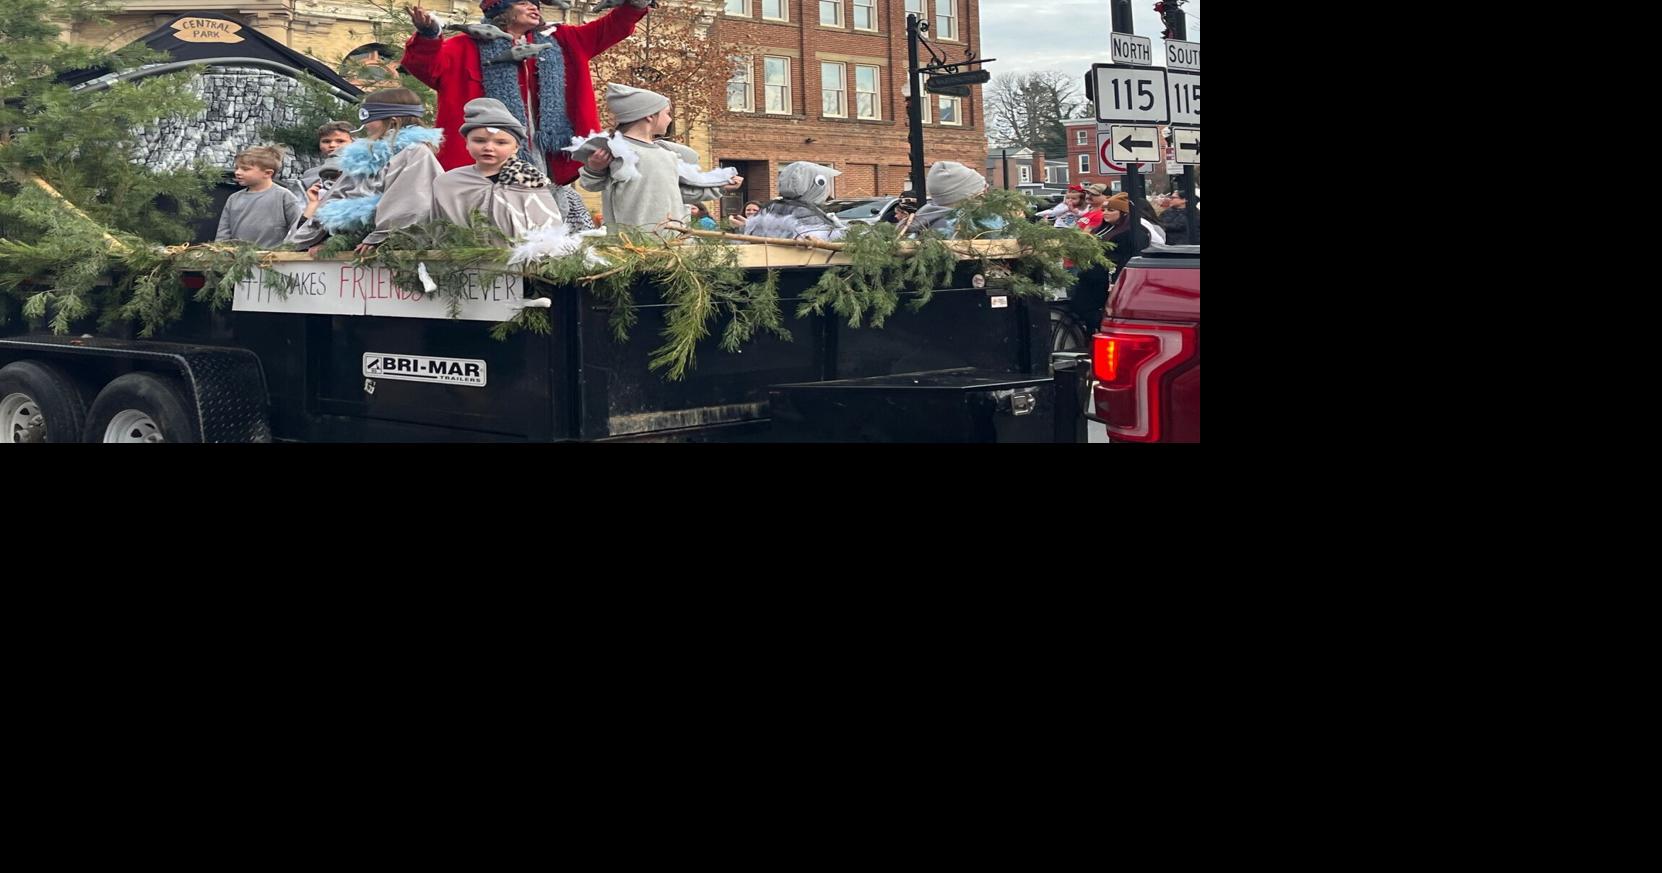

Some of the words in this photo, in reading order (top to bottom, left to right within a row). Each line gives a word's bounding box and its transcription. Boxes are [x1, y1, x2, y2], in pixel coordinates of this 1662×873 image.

[182, 20, 230, 34] CENTRAL
[193, 30, 220, 38] PARK
[1113, 38, 1150, 61] NORTH
[1168, 44, 1200, 66] SOUT
[1111, 78, 1155, 111] 115
[382, 357, 480, 378] BRI-MAR
[440, 375, 481, 383] TRAILERS
